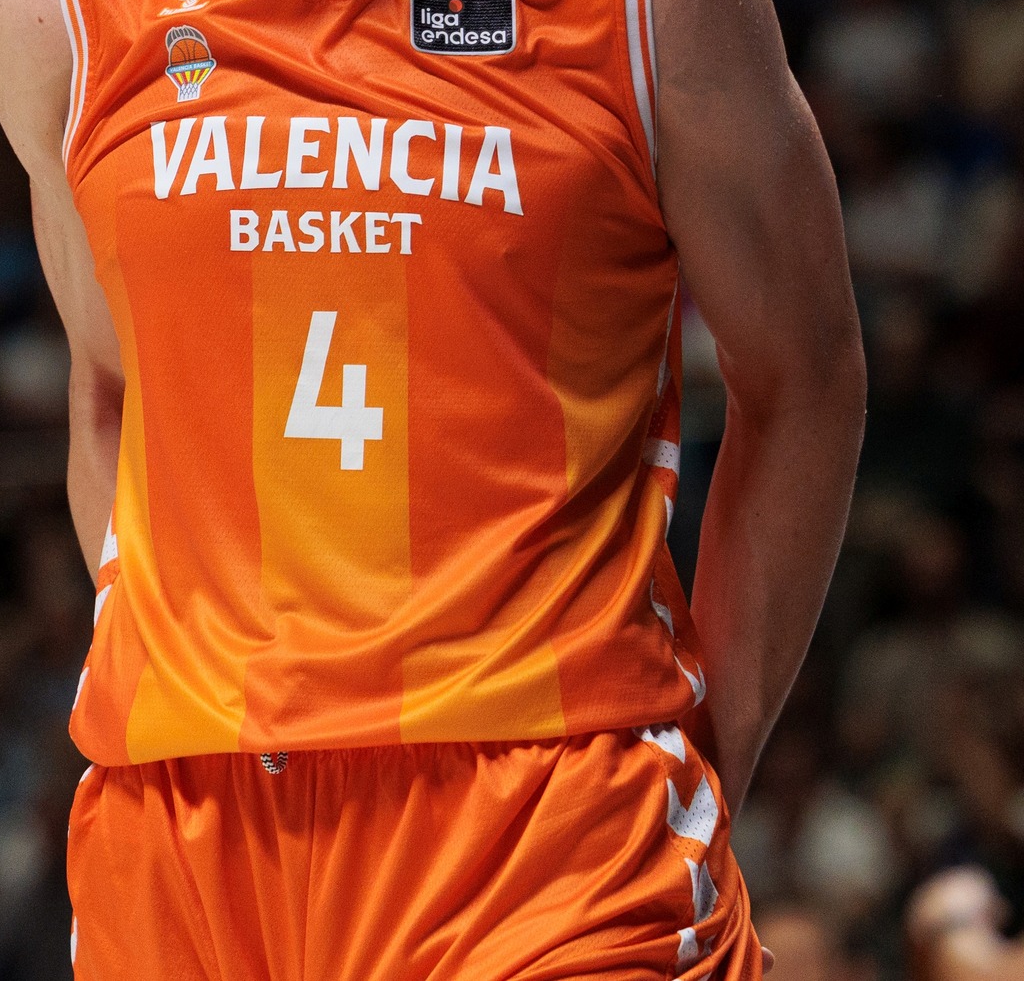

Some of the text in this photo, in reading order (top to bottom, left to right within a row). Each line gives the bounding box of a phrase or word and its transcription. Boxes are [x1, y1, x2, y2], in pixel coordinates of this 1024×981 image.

[420, 7, 459, 29] liga
[421, 27, 506, 45] endesa
[150, 116, 523, 216] VALENCIA
[228, 209, 423, 255] BASKET
[283, 310, 384, 471] 4
